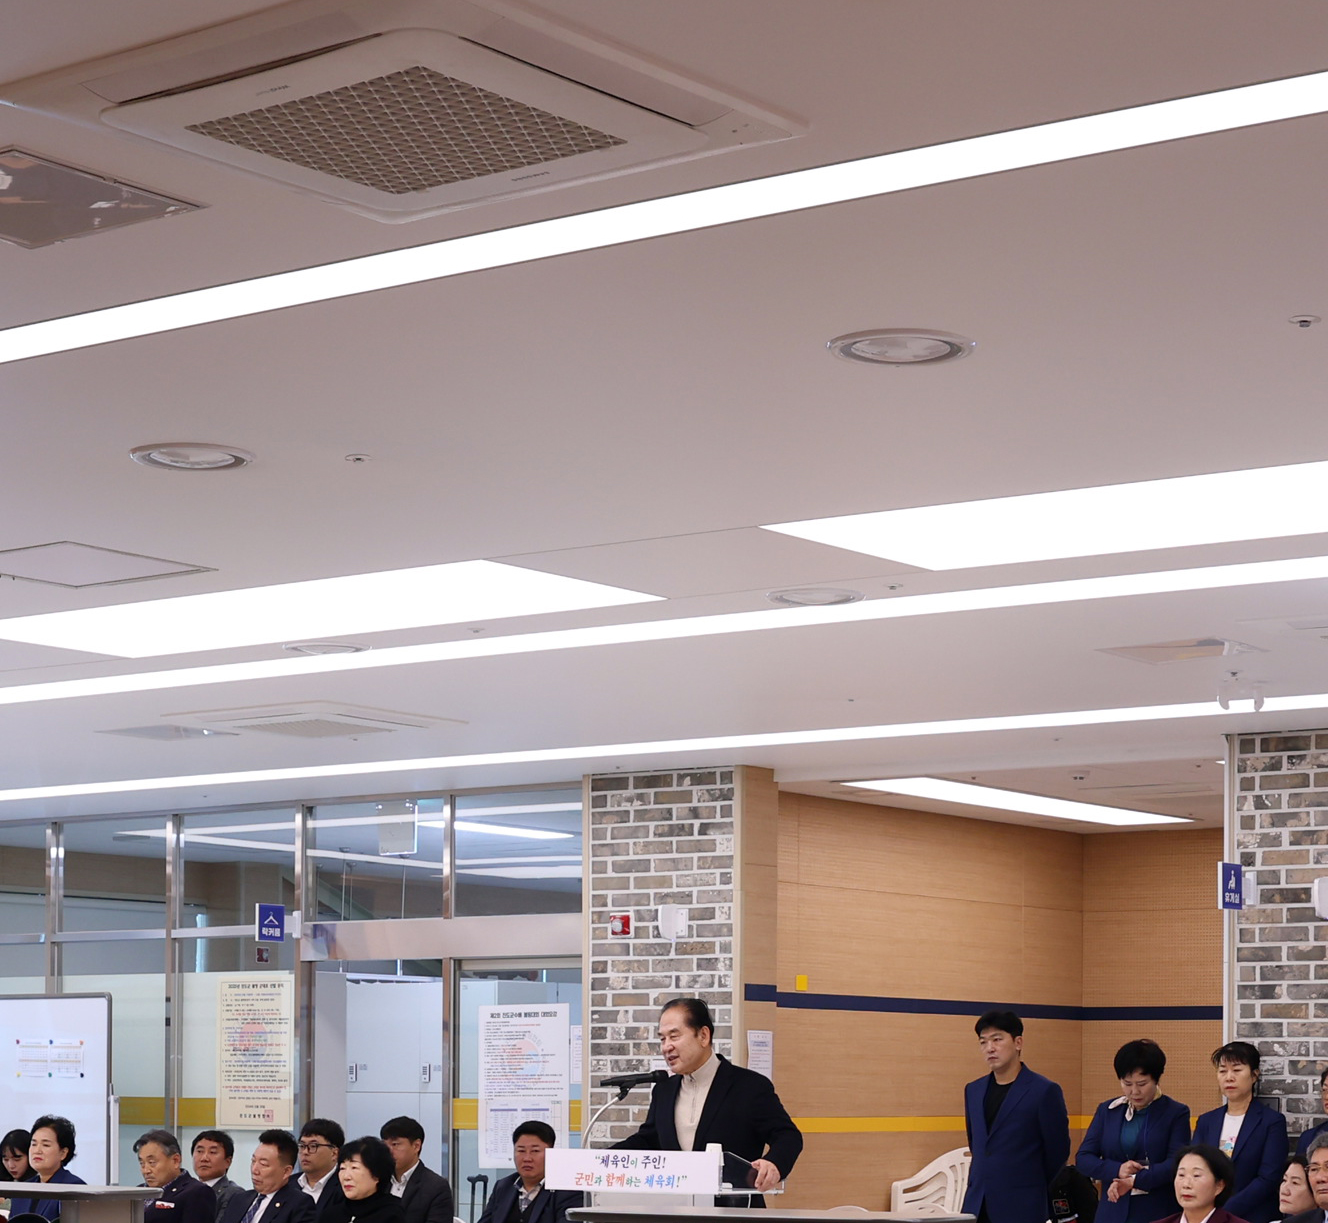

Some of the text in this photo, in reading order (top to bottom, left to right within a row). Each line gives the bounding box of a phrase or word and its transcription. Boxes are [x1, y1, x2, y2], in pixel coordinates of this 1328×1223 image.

[1224, 892, 1240, 904] 휴게실
[261, 927, 281, 938] 락커룸
[595, 1154, 666, 1170] “체육인이 주인!
[574, 1172, 688, 1189] 군민과 함께하는 체육회!”
